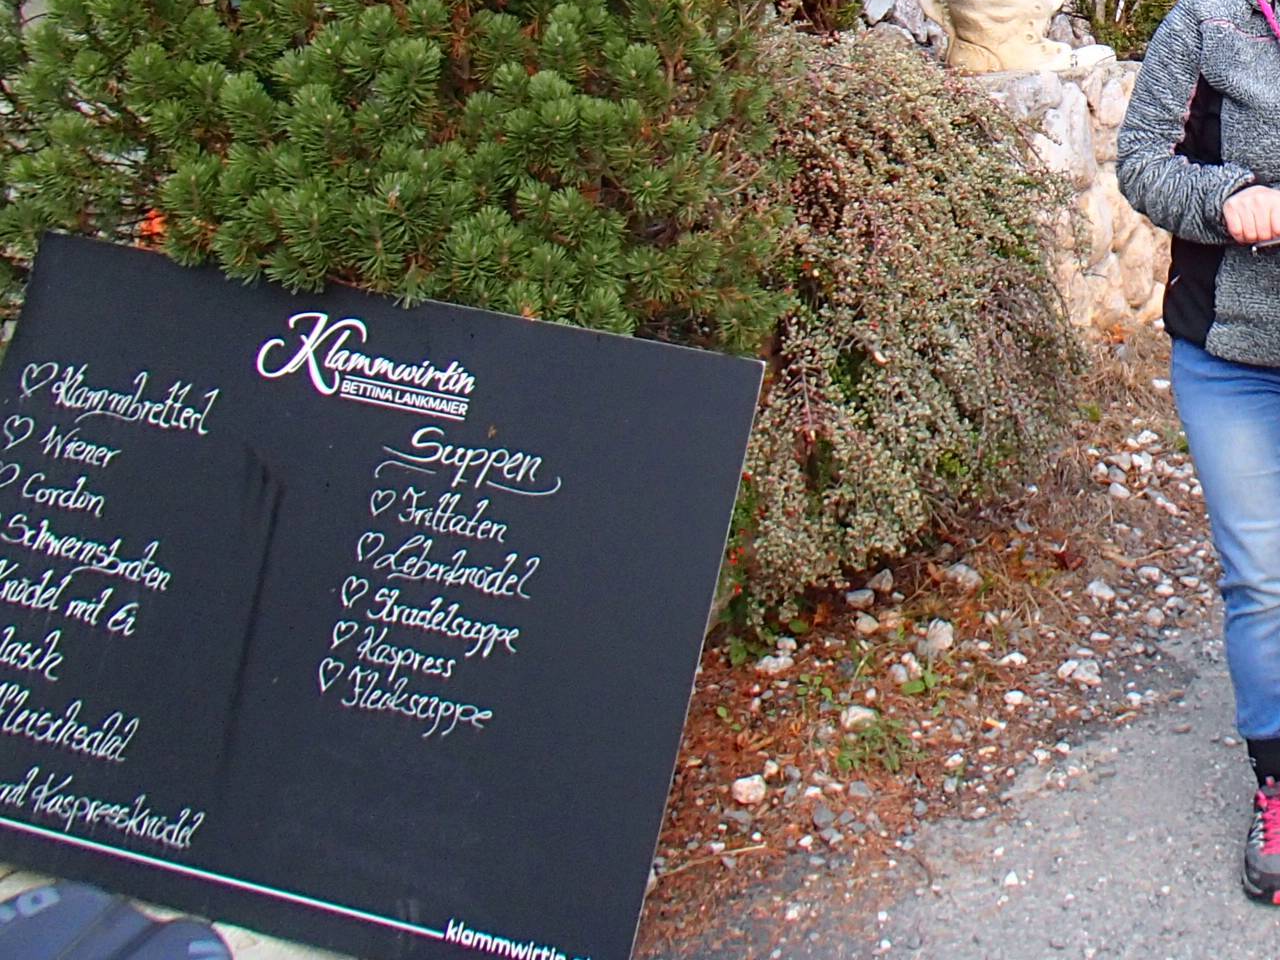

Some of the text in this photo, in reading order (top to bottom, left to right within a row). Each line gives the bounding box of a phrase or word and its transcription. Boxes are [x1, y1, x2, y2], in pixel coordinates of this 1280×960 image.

[257, 312, 475, 395] Klammwirtin
[341, 379, 469, 416] BETTINA LANKMAIER
[41, 424, 121, 468] Wiener
[382, 426, 545, 489] Suppen
[22, 472, 105, 517] Cordon
[399, 487, 508, 543] Frittaten
[1, 513, 171, 591] Schweinsbraten
[65, 588, 113, 625] mit
[107, 601, 140, 636] Ei
[368, 589, 519, 658] Strudelsuppe
[0, 626, 63, 681] lasch
[357, 627, 456, 681] Kaspress
